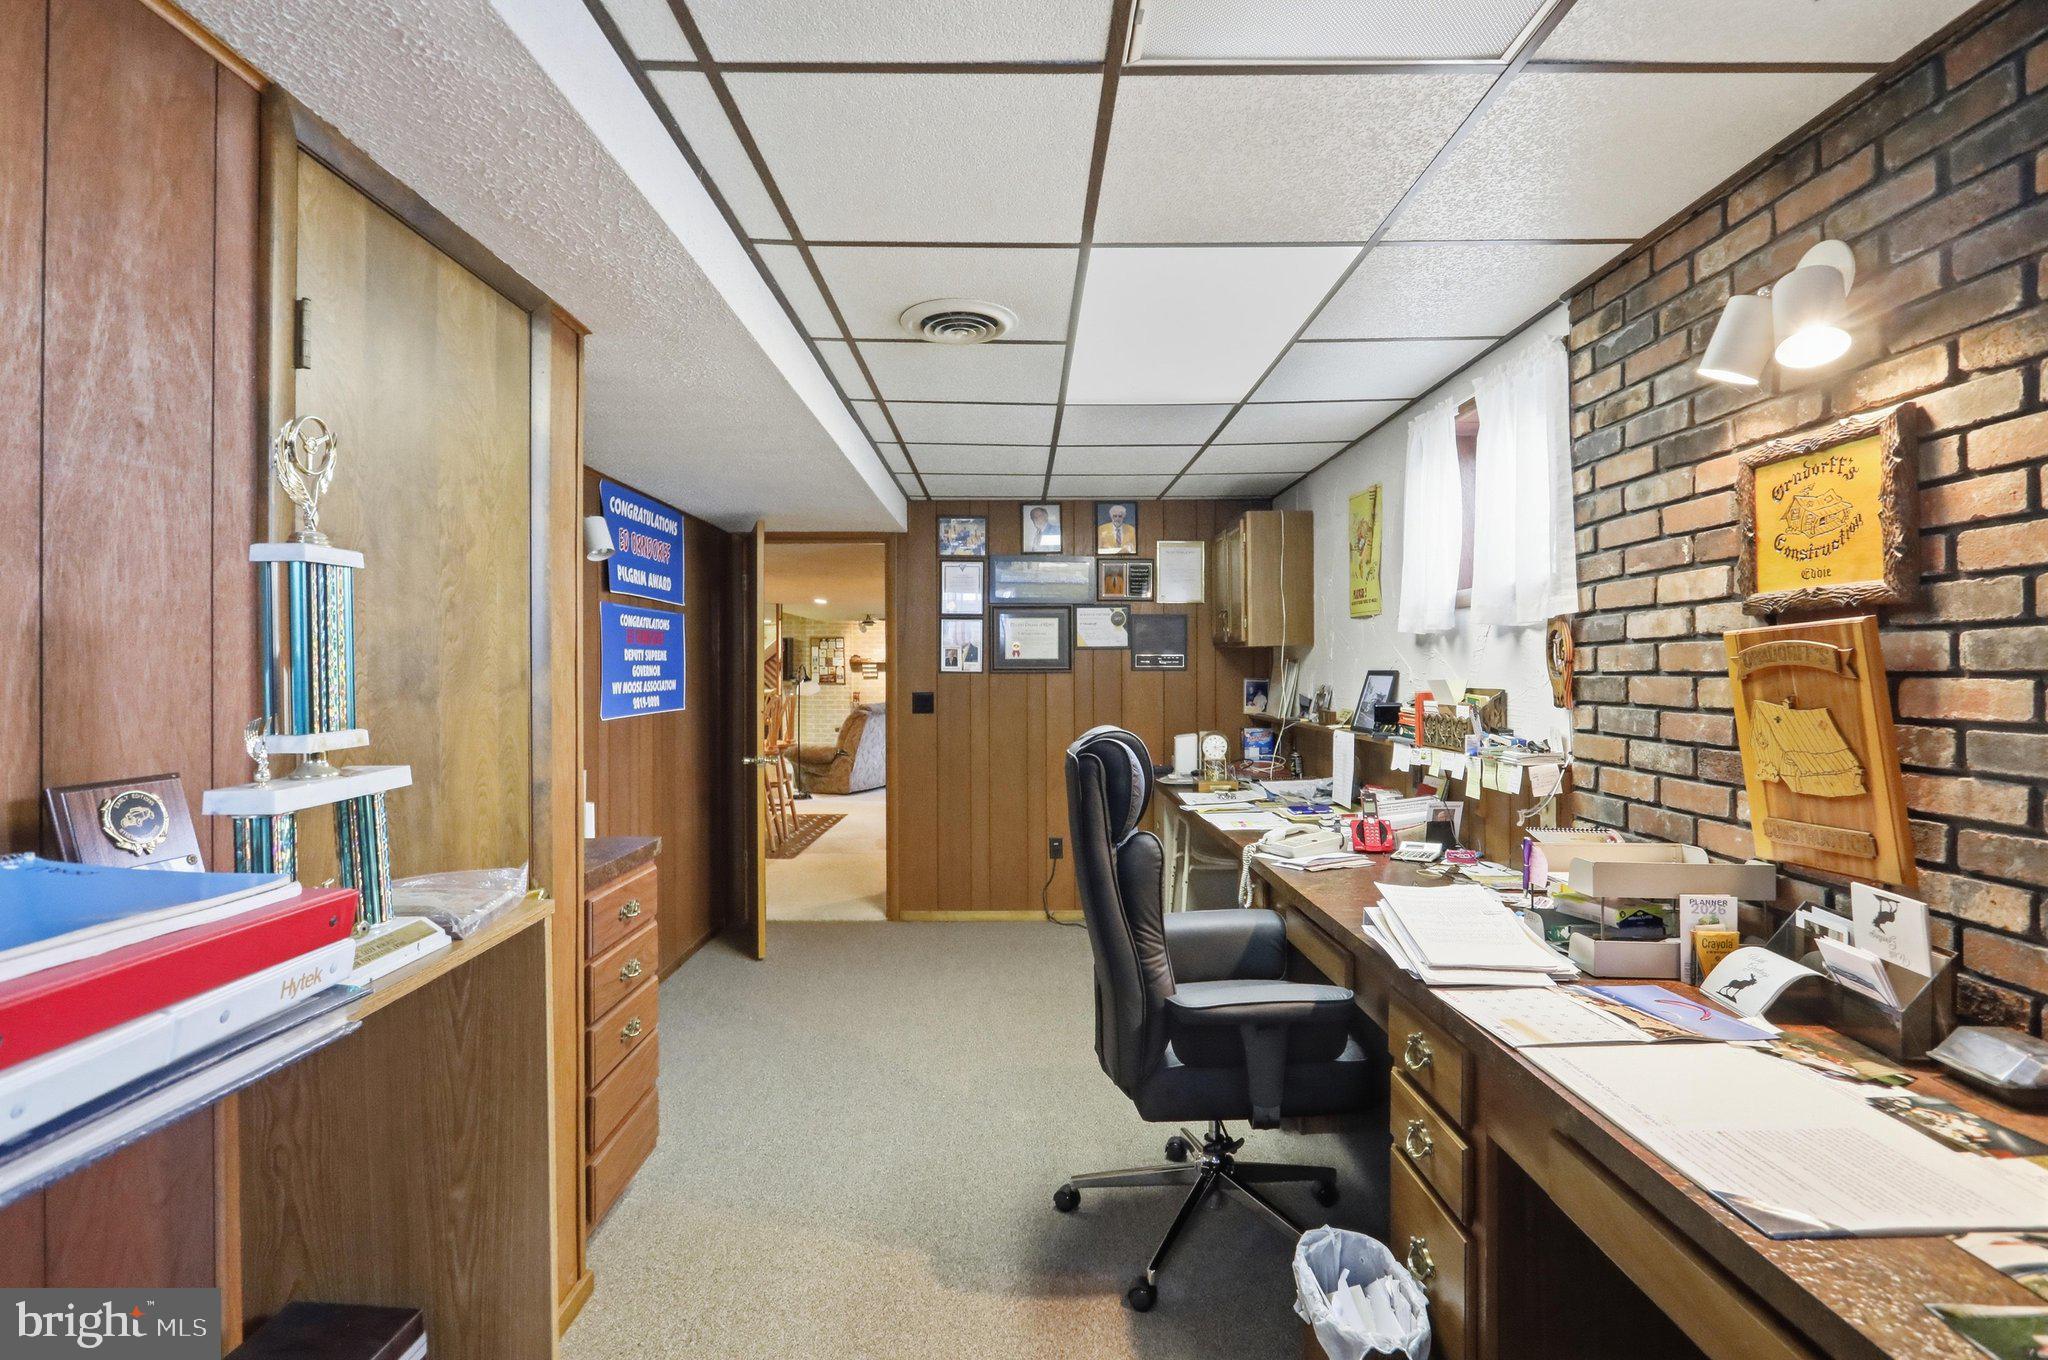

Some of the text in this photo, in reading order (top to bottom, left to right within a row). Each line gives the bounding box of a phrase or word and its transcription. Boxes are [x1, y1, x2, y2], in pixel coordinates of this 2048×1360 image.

[609, 495, 678, 536] CONGRATULATIONS
[1773, 513, 1864, 562] Construction
[616, 564, 673, 592] PILGRIM AWARD
[1800, 567, 1832, 580] Eddie
[620, 613, 671, 631] CONGRATULATIONS
[624, 648, 644, 661] DEPUTY
[632, 664, 661, 677] GOVERNOR
[623, 680, 643, 694] MOOSE
[643, 679, 677, 693] ASSOCIATION
[1689, 898, 1728, 907] PLANNER
[1690, 903, 1728, 915] 2026
[1701, 938, 1733, 951] Crayola
[280, 967, 323, 1000] Hytek
